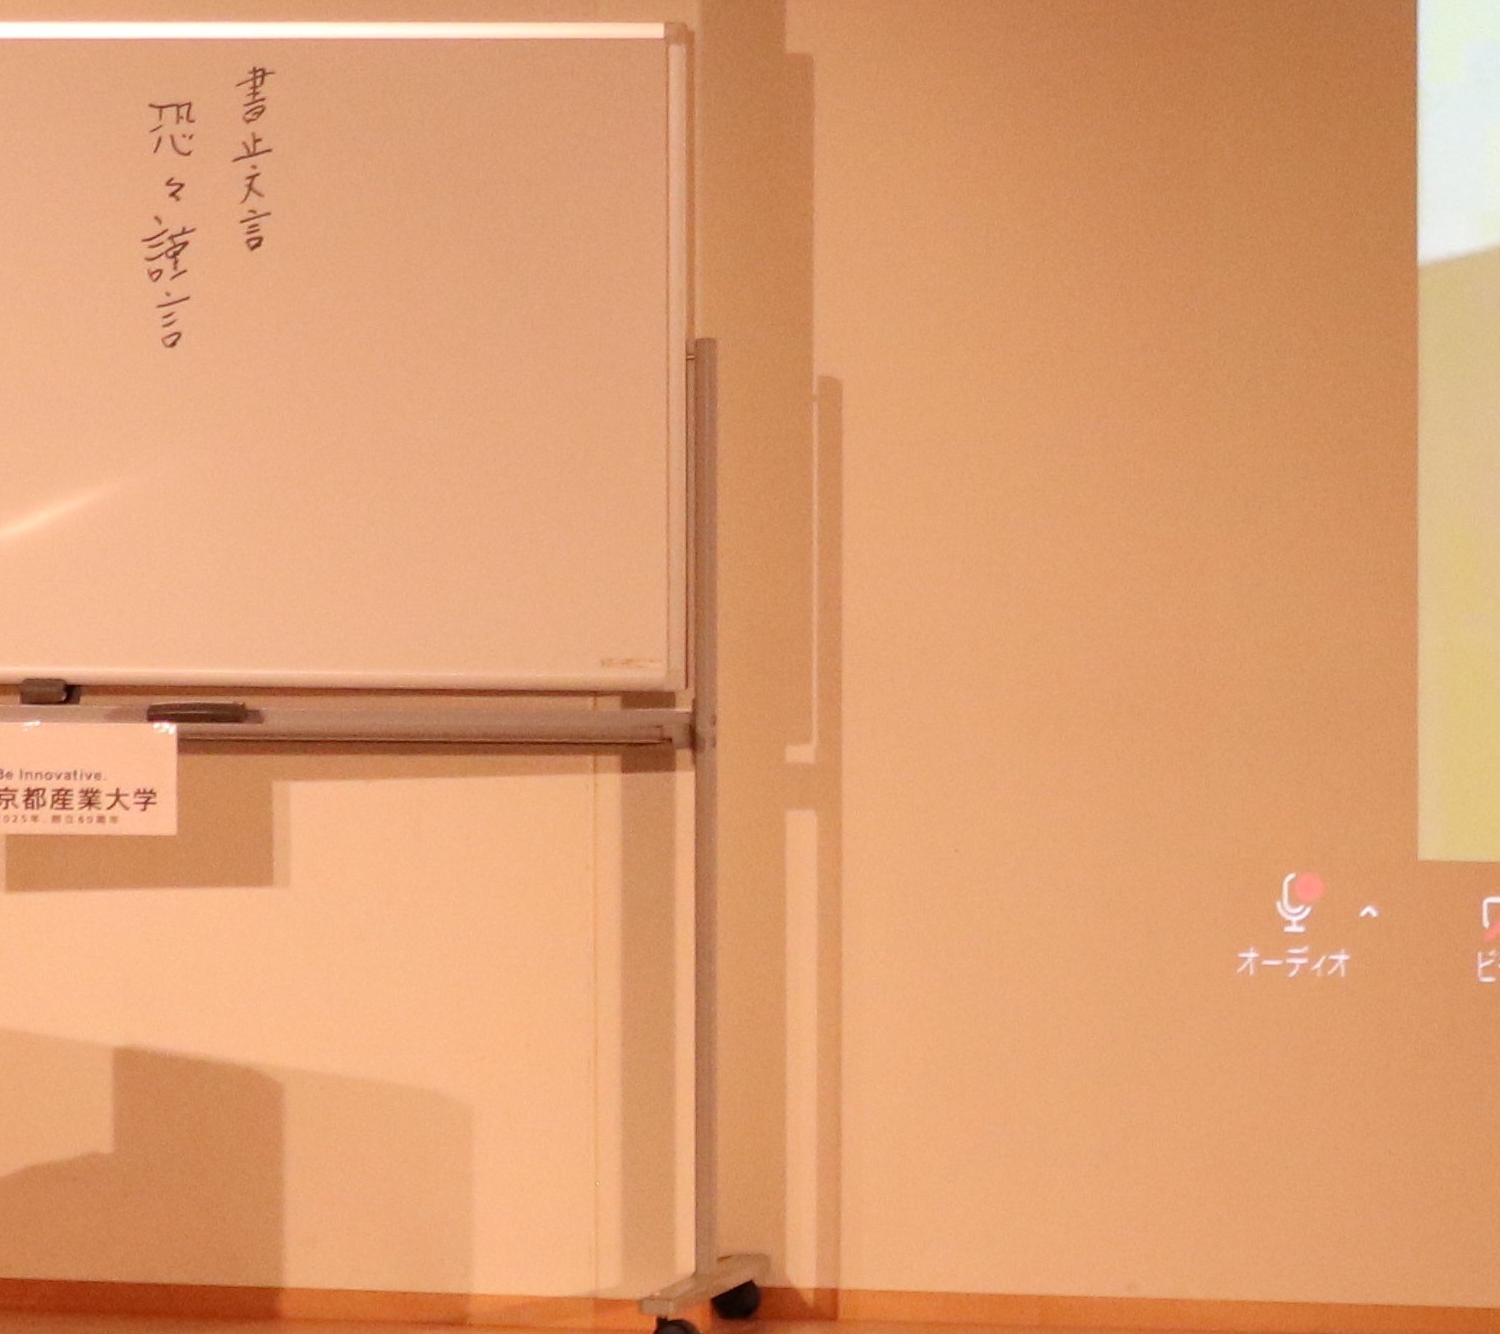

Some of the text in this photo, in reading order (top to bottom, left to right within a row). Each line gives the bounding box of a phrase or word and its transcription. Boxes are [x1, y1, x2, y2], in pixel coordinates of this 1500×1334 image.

[1237, 946, 1350, 977] オーディオ
